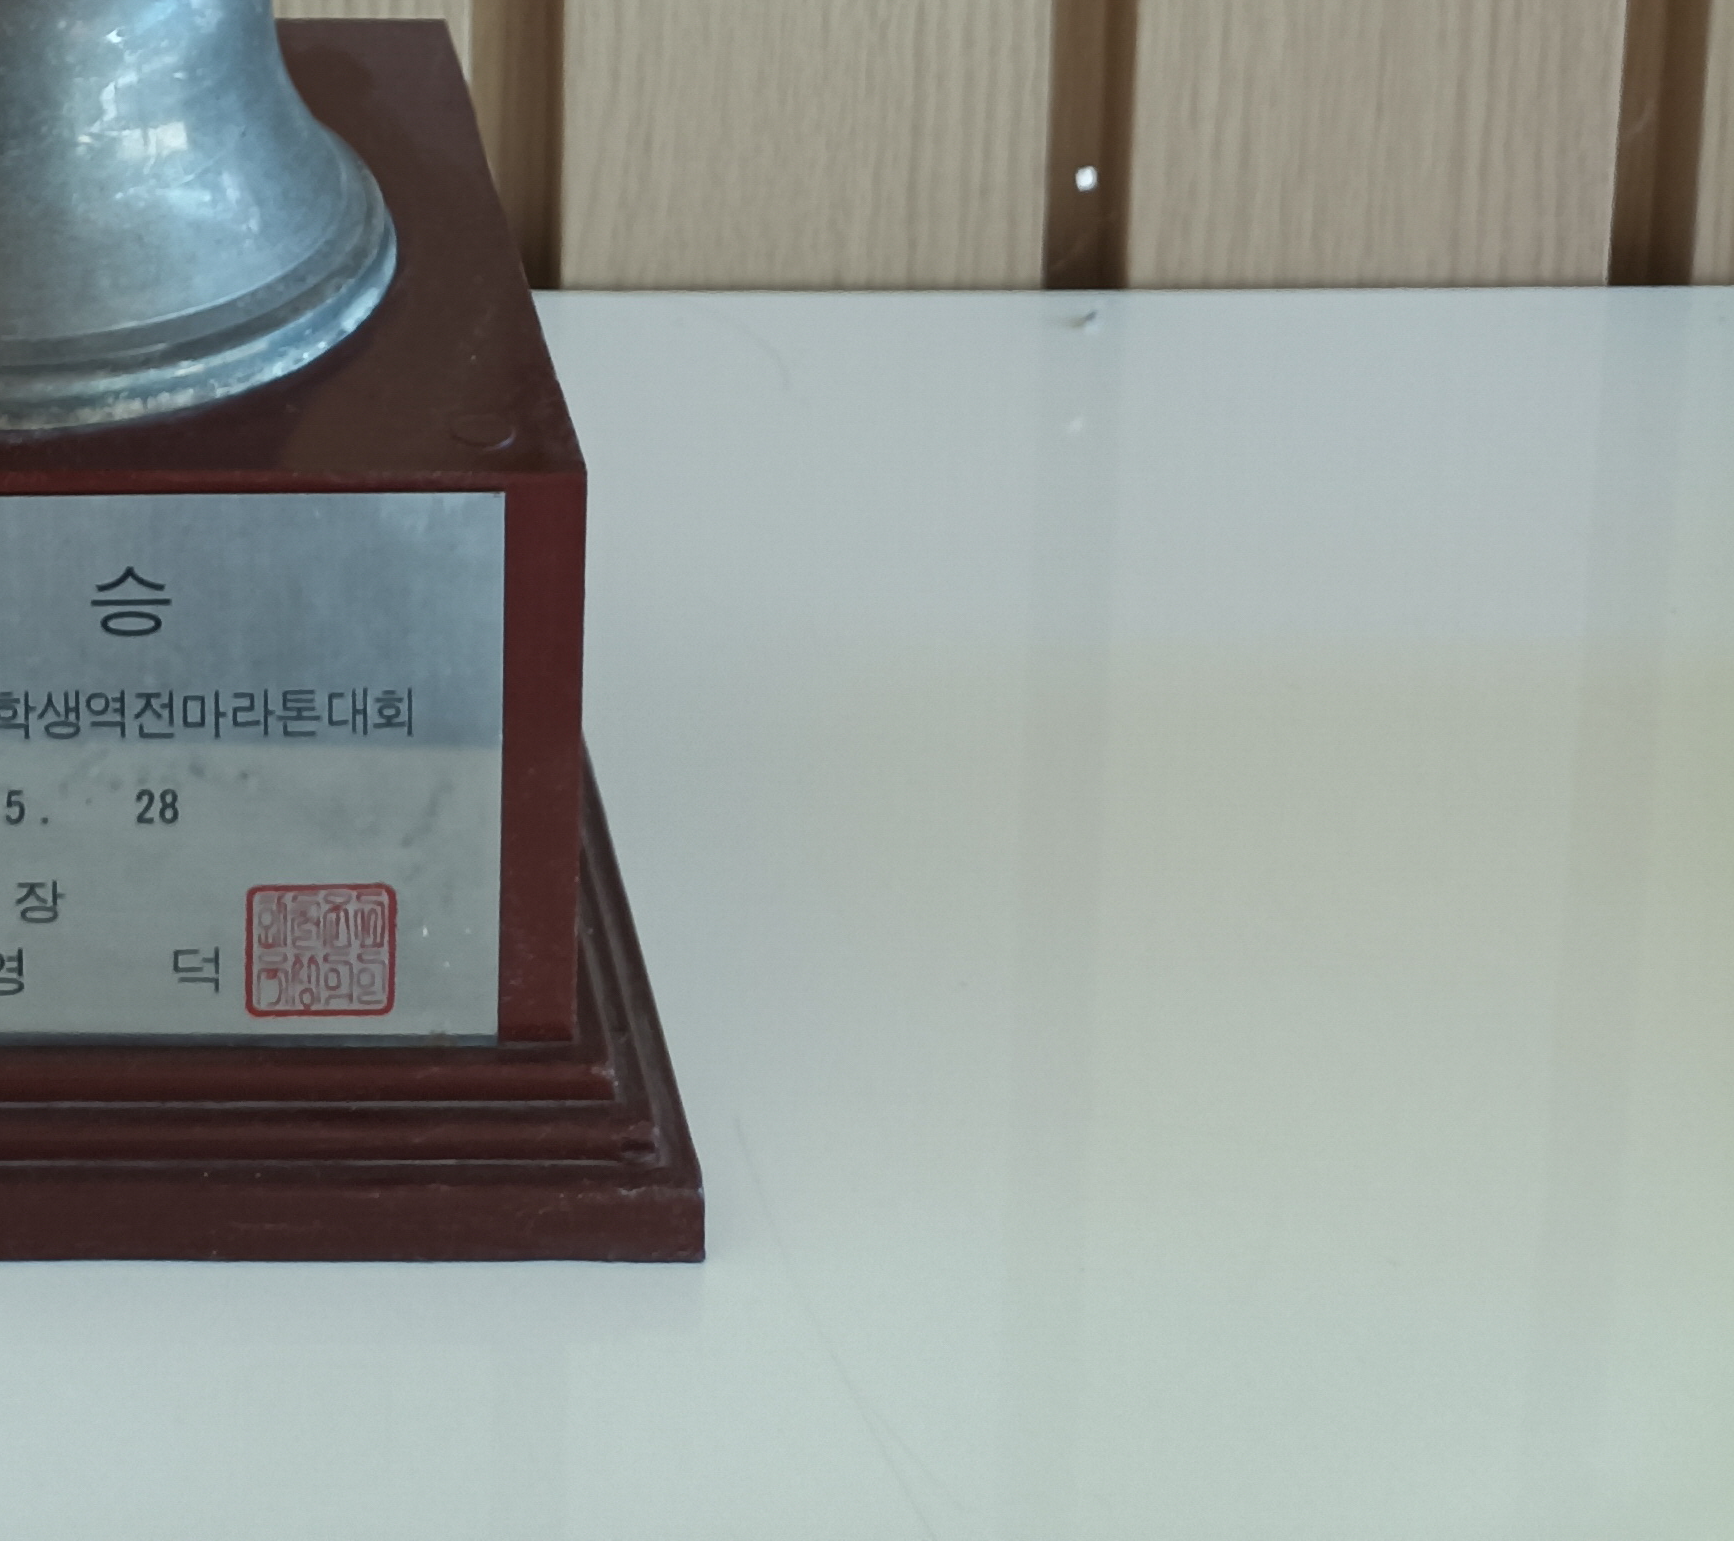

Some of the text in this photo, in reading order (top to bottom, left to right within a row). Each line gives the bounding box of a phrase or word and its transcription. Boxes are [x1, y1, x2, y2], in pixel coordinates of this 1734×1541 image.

[90, 565, 173, 638] 승
[4, 789, 50, 827] 5.
[135, 788, 180, 827] 28
[172, 945, 220, 995] 덕
